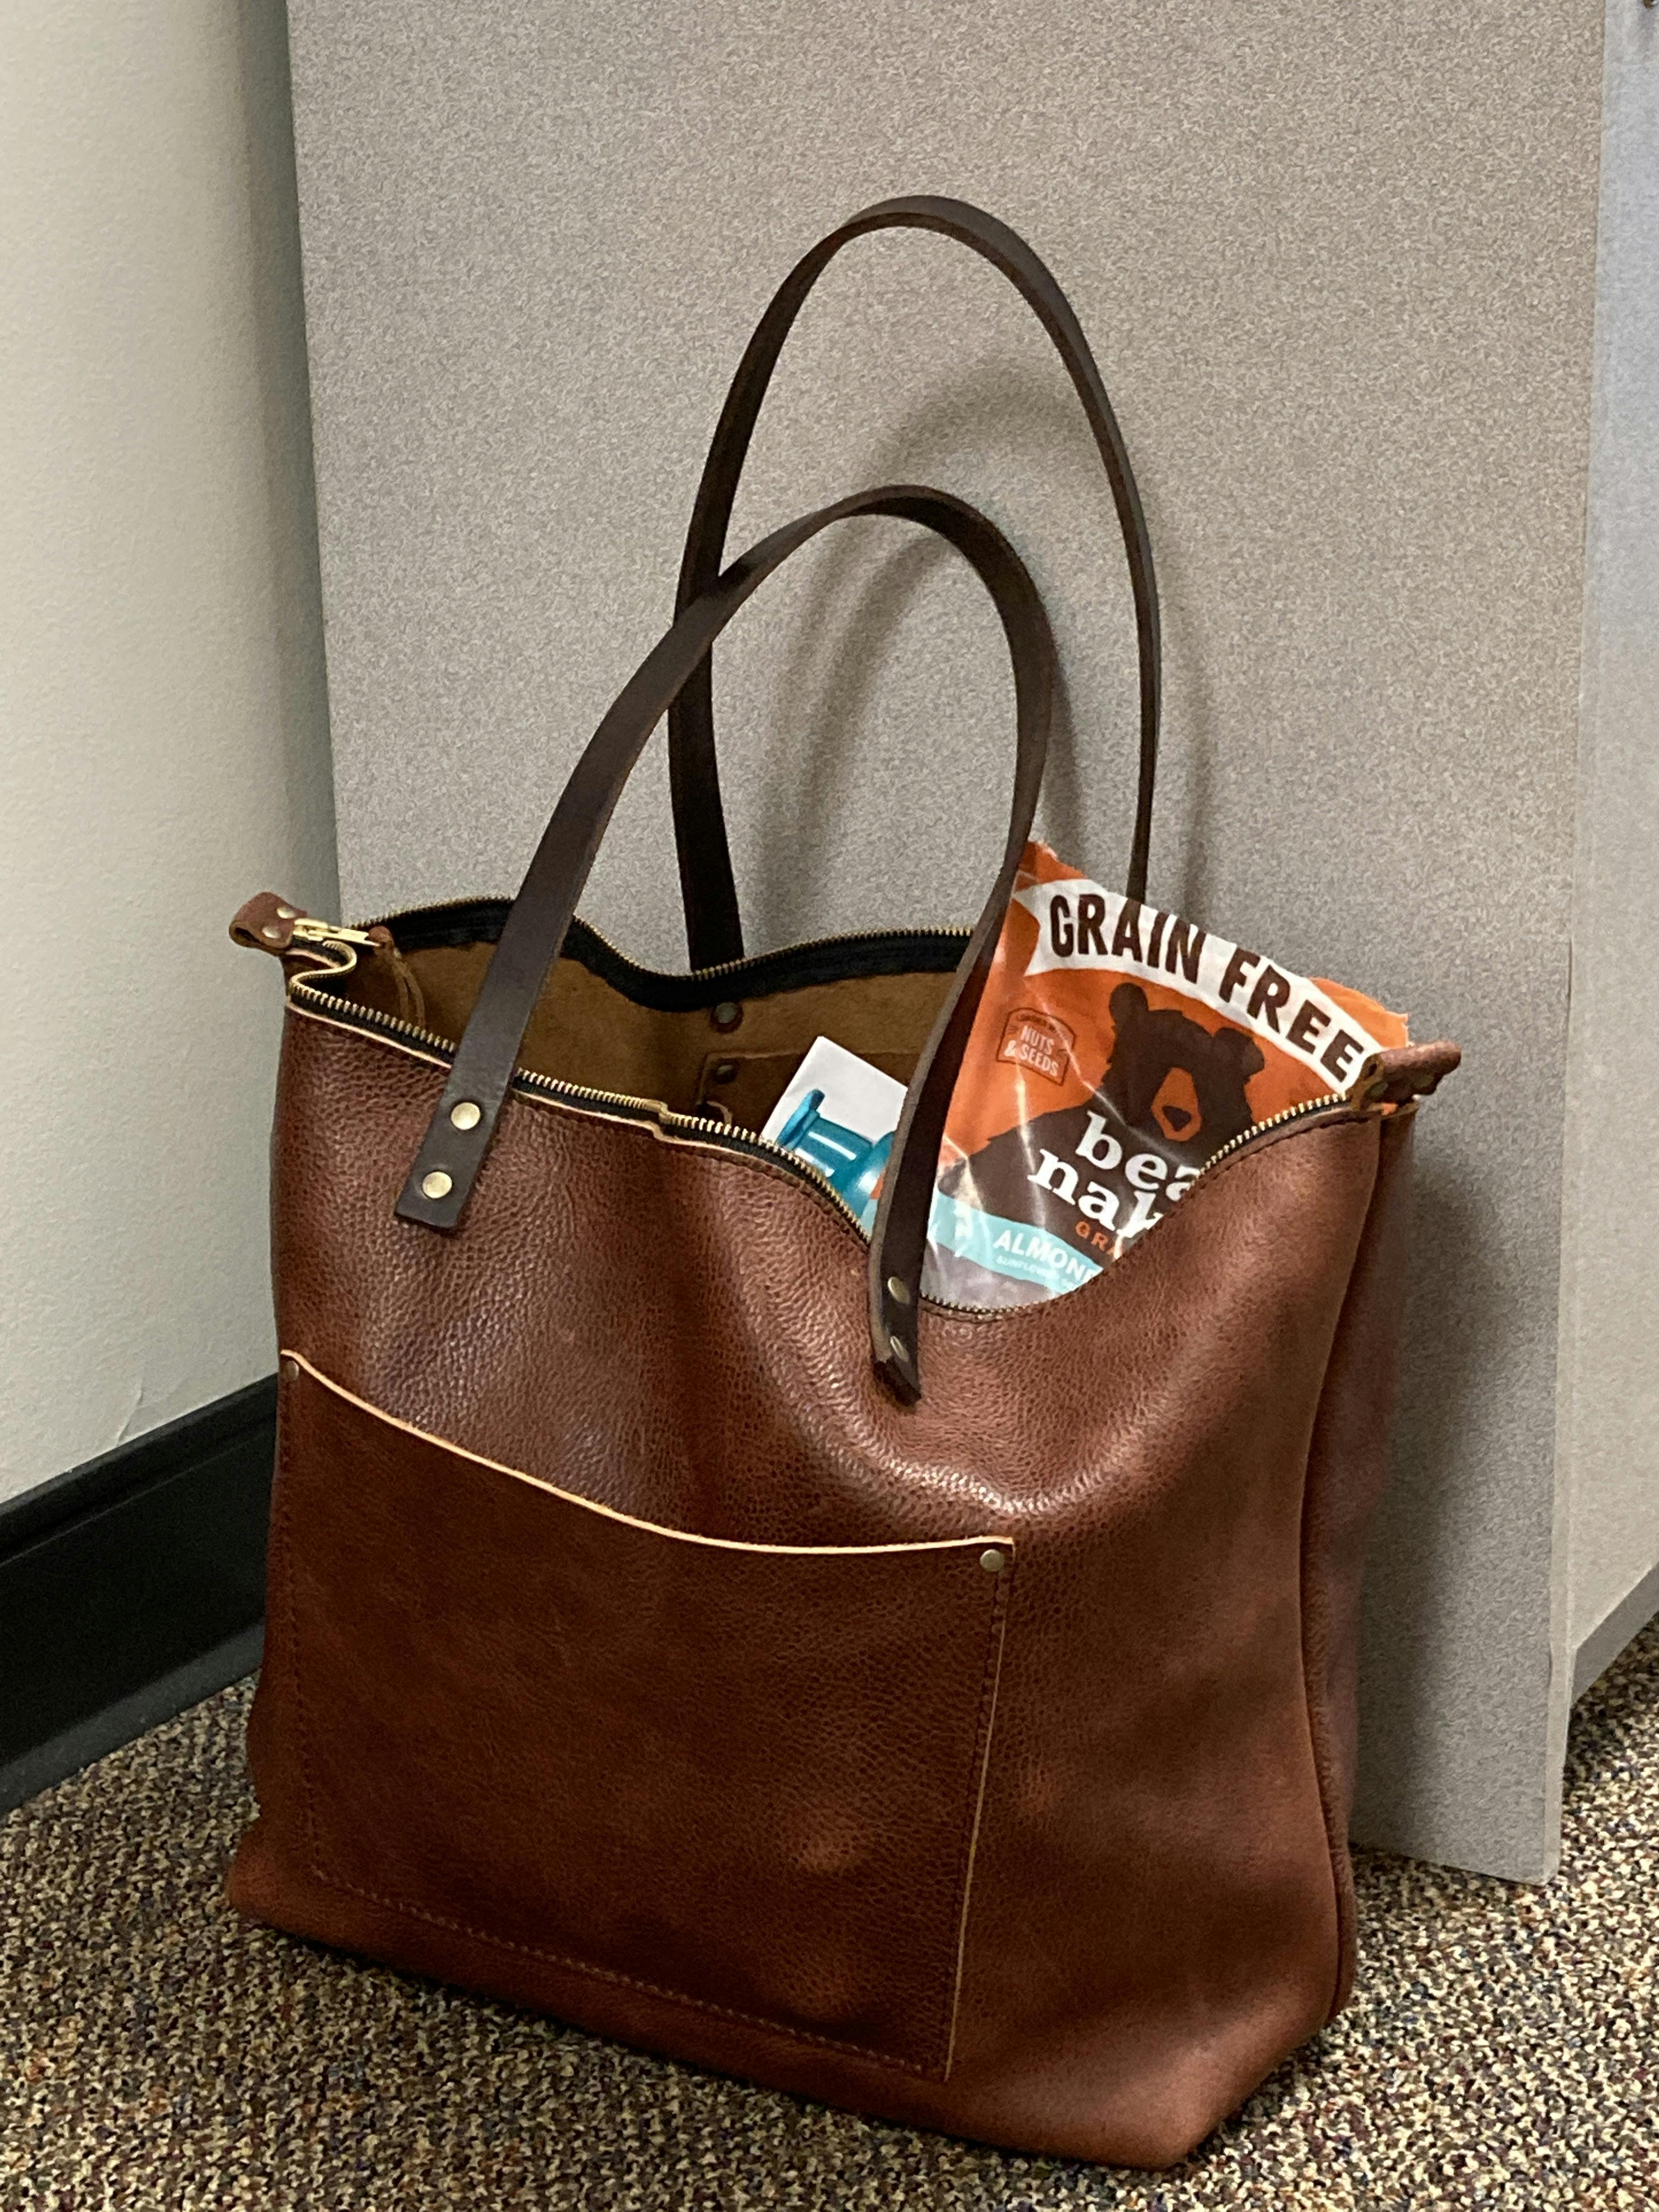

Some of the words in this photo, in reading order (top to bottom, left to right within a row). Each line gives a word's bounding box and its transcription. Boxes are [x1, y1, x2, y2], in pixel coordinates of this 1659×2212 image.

[1050, 894, 1207, 984] GRAIN
[1218, 947, 1364, 1082] FREE
[1004, 1040, 1017, 1057] &
[1019, 1043, 1059, 1076] SEEDS
[1020, 1025, 1054, 1055] NUTS
